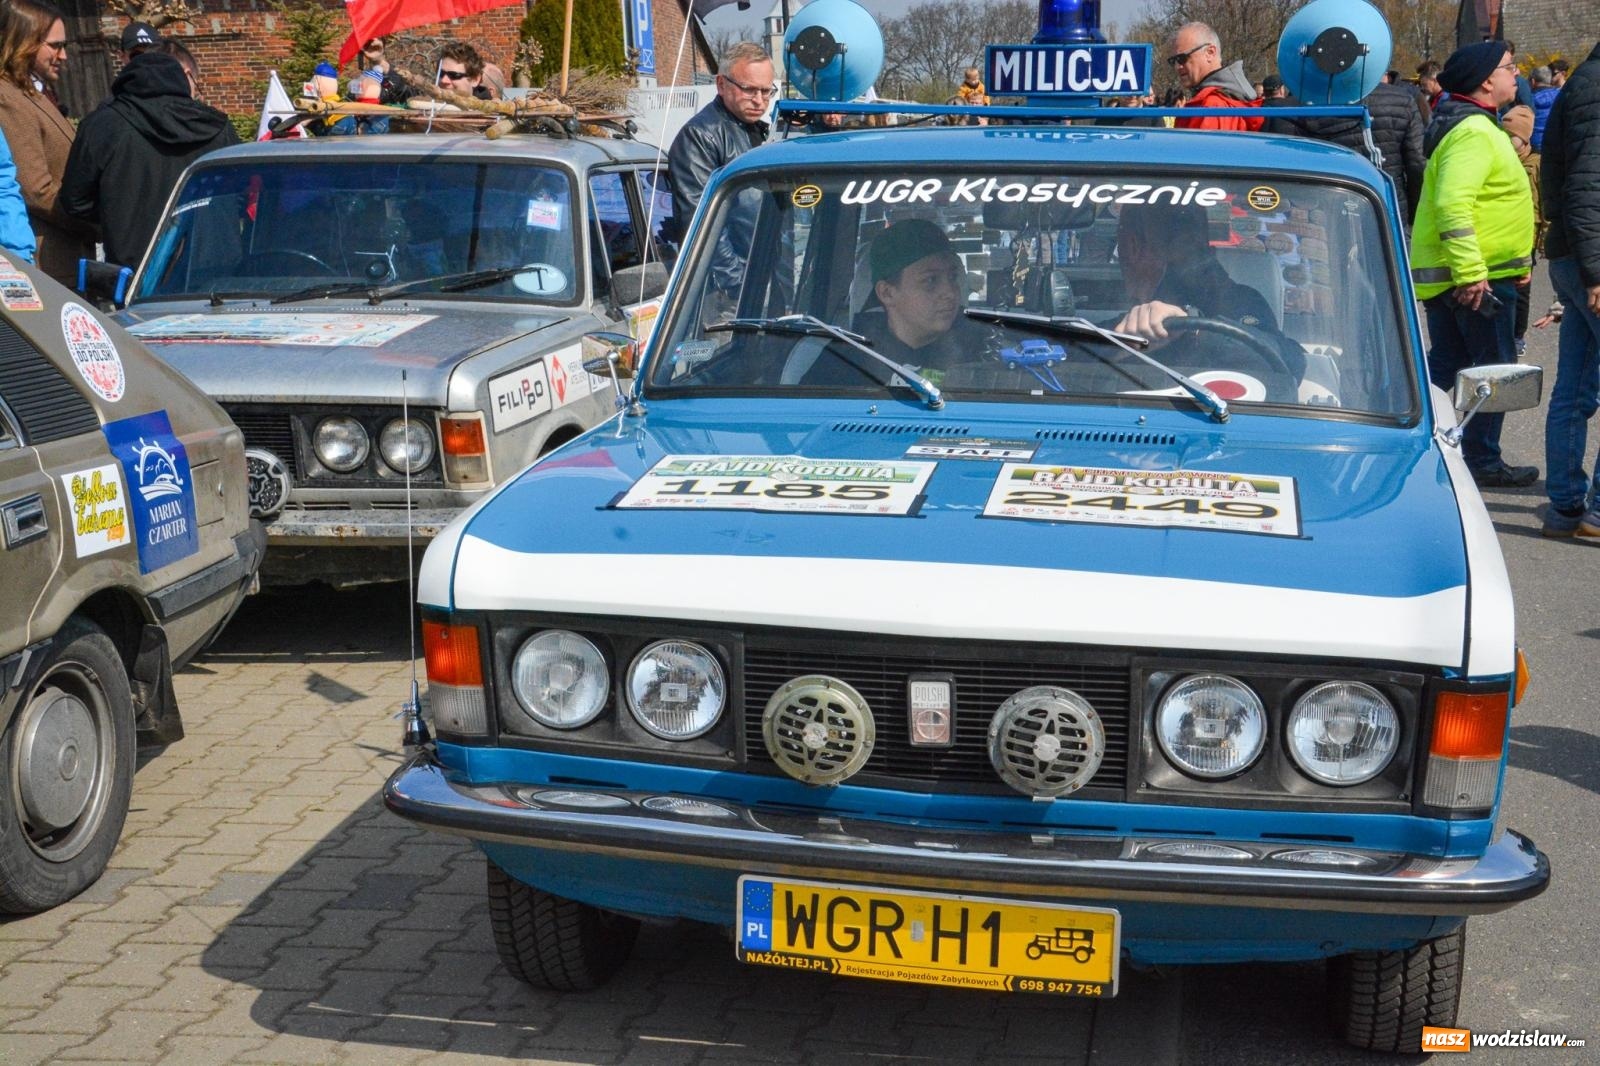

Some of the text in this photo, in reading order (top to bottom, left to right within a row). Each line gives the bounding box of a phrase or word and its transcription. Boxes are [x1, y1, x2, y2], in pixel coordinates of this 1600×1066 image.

[636, 0, 649, 46] P
[994, 49, 1138, 92] MILICJA
[840, 178, 1227, 208] WGR Klasycznie
[76, 349, 114, 362] DO POLSKI
[497, 379, 544, 414] FILIPPO
[920, 446, 1021, 457] STAFF
[684, 461, 768, 473] RAJD
[770, 461, 896, 478] KOGUTA
[656, 479, 892, 501] 1185
[1031, 471, 1117, 486] RAJD
[1123, 475, 1258, 493] KOGUTA
[149, 499, 182, 525] MARIAN
[1003, 491, 1278, 519] 2449
[148, 517, 187, 546] CZARTER
[915, 686, 947, 702] POLSKI
[747, 922, 768, 939] PL
[785, 890, 1002, 968] WGR H1
[746, 951, 829, 971] NAŻÓŁTEJ.PL
[846, 965, 1000, 987] Rejestracja Pojazdów Zabytkowych
[1019, 979, 1102, 995] 698 947 754
